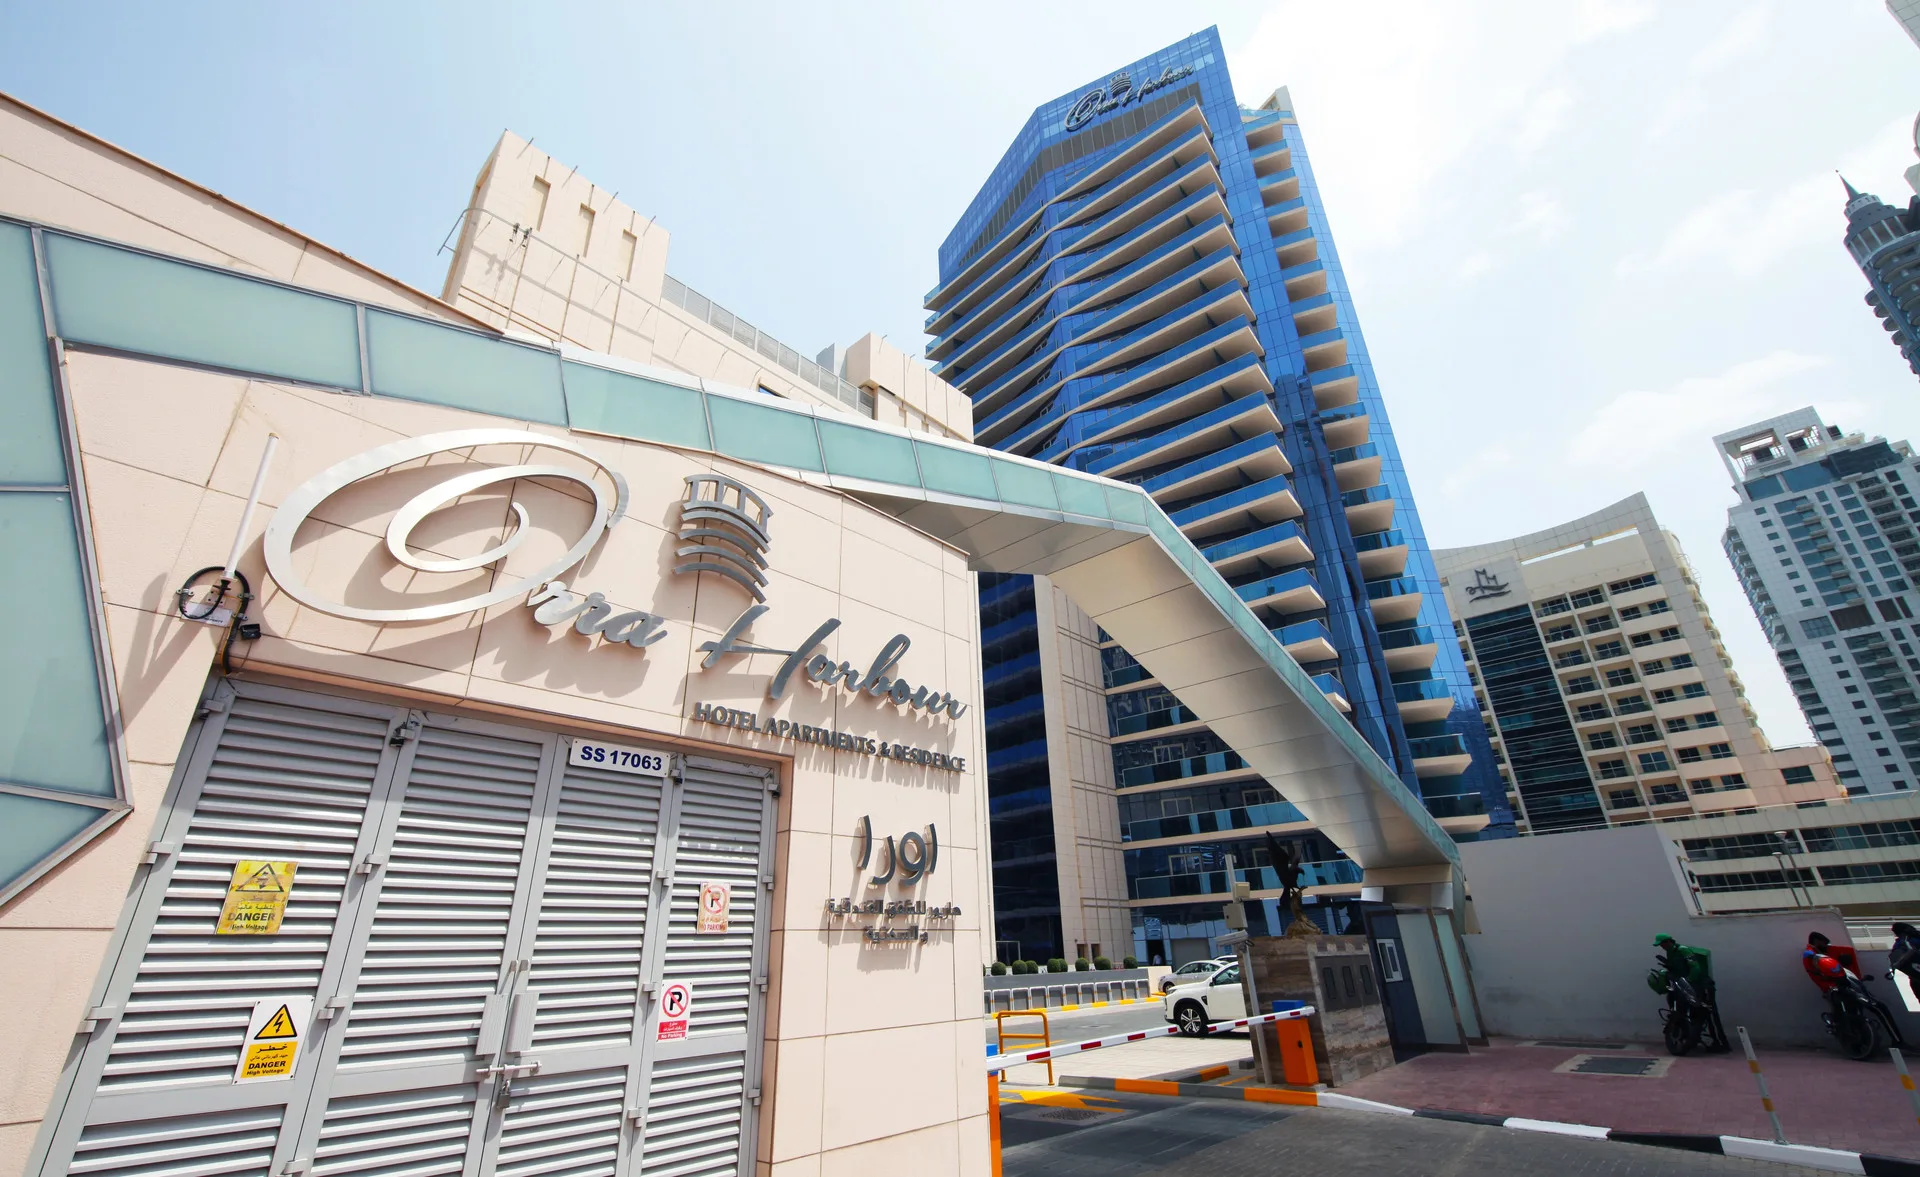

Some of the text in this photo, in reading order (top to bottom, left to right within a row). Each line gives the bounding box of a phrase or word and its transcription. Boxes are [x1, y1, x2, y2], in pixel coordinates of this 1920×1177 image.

[1121, 64, 1194, 108] Harbour
[695, 604, 967, 720] Harbour
[694, 701, 966, 773] HOTEL APARTMENTS & RESIDENCE
[581, 745, 662, 771] SS 17063
[227, 912, 275, 921] DANGER
[256, 1043, 288, 1054] خطر
[248, 1060, 287, 1070] DANGER
